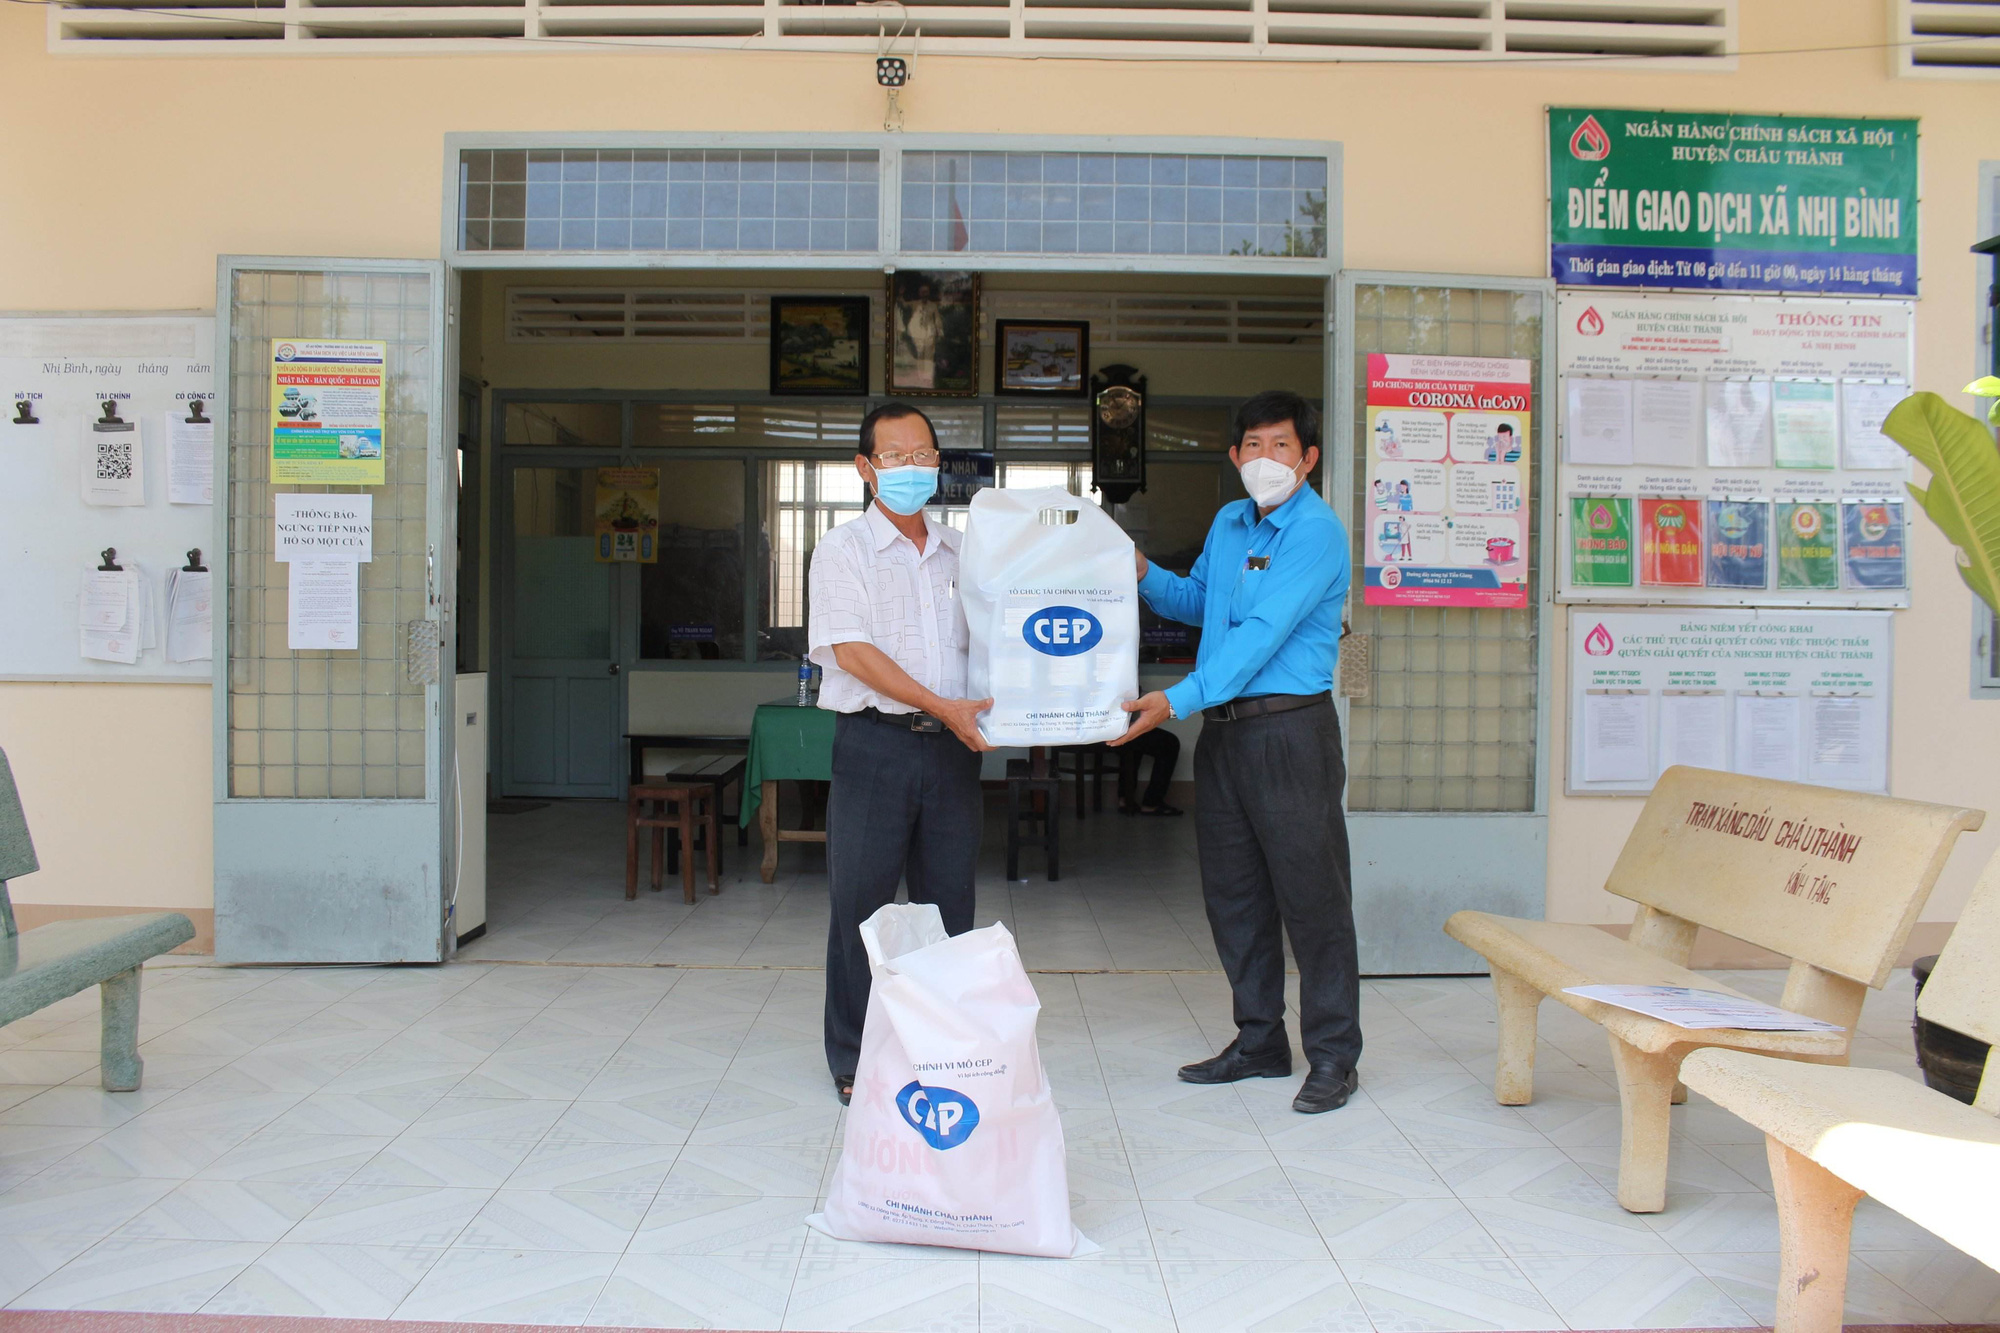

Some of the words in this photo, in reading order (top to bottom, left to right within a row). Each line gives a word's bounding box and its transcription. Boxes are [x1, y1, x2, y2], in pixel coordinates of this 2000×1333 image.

[1625, 123, 1673, 138] NGÂN
[1678, 122, 1724, 139] HÀNG
[1731, 125, 1782, 142] CHÍNH
[1787, 126, 1831, 143] SÁCH
[1836, 128, 1857, 144] XÃ
[1863, 129, 1893, 147] HỘI
[1672, 145, 1730, 163] HUYỆN
[1734, 147, 1781, 164] CHÂU
[1785, 148, 1843, 166] THÀNH
[1568, 167, 1628, 229] ĐIỂM
[1636, 190, 1690, 232] GIAO
[1698, 192, 1751, 242] DỊCH
[1759, 185, 1790, 235] XÃ
[1798, 196, 1837, 246] NHỊ
[1844, 188, 1899, 238] BÌNH
[1569, 258, 1594, 273] Thời
[1597, 260, 1620, 277] gian
[1623, 261, 1645, 278] giao
[1648, 261, 1674, 276] dịch:
[1676, 261, 1691, 276] Từ
[1694, 263, 1705, 276] 08
[1708, 263, 1724, 279] giờ
[1728, 261, 1748, 278] đến
[1751, 265, 1762, 278] 11
[1764, 265, 1780, 281] giờ
[1783, 267, 1798, 281] 00,
[1801, 267, 1826, 283] ngày
[1829, 268, 1840, 280] 14
[1843, 267, 1869, 284] hàng
[1872, 268, 1902, 284] tháng
[1612, 311, 1635, 319] NGÂN
[1638, 311, 1662, 320] HÀNG
[1664, 311, 1691, 321] CHÍNH
[1693, 312, 1716, 322] SÁCH
[1718, 312, 1729, 322] XÃ
[1732, 315, 1747, 323] HỘI
[1777, 311, 1843, 326] THÔNG
[1850, 316, 1882, 326] TIN
[1637, 323, 1665, 333] HUYỆN
[1668, 324, 1691, 333] CHÂU
[1694, 324, 1722, 334] THÀNH
[42, 363, 61, 376] Nhị
[64, 363, 92, 374] Bình,
[95, 364, 121, 376] ngày
[138, 363, 168, 376] tháng
[187, 364, 210, 373] năm
[278, 376, 295, 384] NHẬT
[297, 375, 309, 383] BẢN
[314, 375, 328, 384] HÀN
[329, 375, 345, 385] QUỐC
[350, 376, 361, 384] ĐÀI
[1385, 380, 1413, 389] CHỦNG
[1415, 381, 1430, 389] MỚI
[1431, 382, 1447, 390] CỦA
[1459, 383, 1474, 391] RÚT
[109, 391, 130, 399] CHÍNH
[176, 391, 184, 399] CÓ
[188, 391, 206, 399] CÔNG
[1409, 391, 1476, 407] CORONA
[1478, 395, 1525, 411] (nCoV)
[952, 457, 978, 478] NHẬN
[317, 523, 339, 533] TIẾP
[342, 525, 370, 535] NHẬN
[284, 535, 298, 544] HỒ
[301, 536, 315, 544] SƠ
[317, 537, 338, 547] MỘT
[343, 536, 363, 546] CỬA
[1608, 536, 1627, 550] BÁO
[1009, 586, 1018, 595] TỔ
[1034, 618, 1091, 644] CEP
[1680, 622, 1707, 631] BẢNG
[1711, 623, 1735, 632] NIÊM
[1739, 622, 1757, 632] YẾT
[1760, 624, 1786, 632] CÔNG
[1623, 634, 1643, 644] CÁC
[1646, 634, 1666, 644] THỦ
[1669, 637, 1688, 645] TỤC
[1691, 635, 1712, 644] GIẢI
[1715, 635, 1747, 645] QUYẾT
[1750, 636, 1776, 645] CÔNG
[1780, 637, 1802, 647] VIỆC
[1806, 637, 1838, 647] THUỘC
[1842, 636, 1869, 646] THẨM
[1618, 646, 1651, 657] QUYỀN
[1653, 647, 1674, 657] GIẢI
[1677, 648, 1709, 658] QUYẾT
[1712, 648, 1731, 658] CỦA
[1776, 650, 1808, 660] HUYỆN
[1810, 650, 1837, 659] CHÂU
[1840, 651, 1873, 659] THÀNH
[1039, 711, 1064, 719] NHÁNH
[1811, 822, 1862, 863] THÀNH
[913, 1062, 942, 1071] CHÍNH
[945, 1062, 954, 1070] VI
[957, 1059, 972, 1068] MÔ
[975, 1059, 992, 1067] CEP
[886, 1200, 899, 1208] CHI
[902, 1203, 932, 1216] NHÁNH
[934, 1210, 958, 1221] CHÂU
